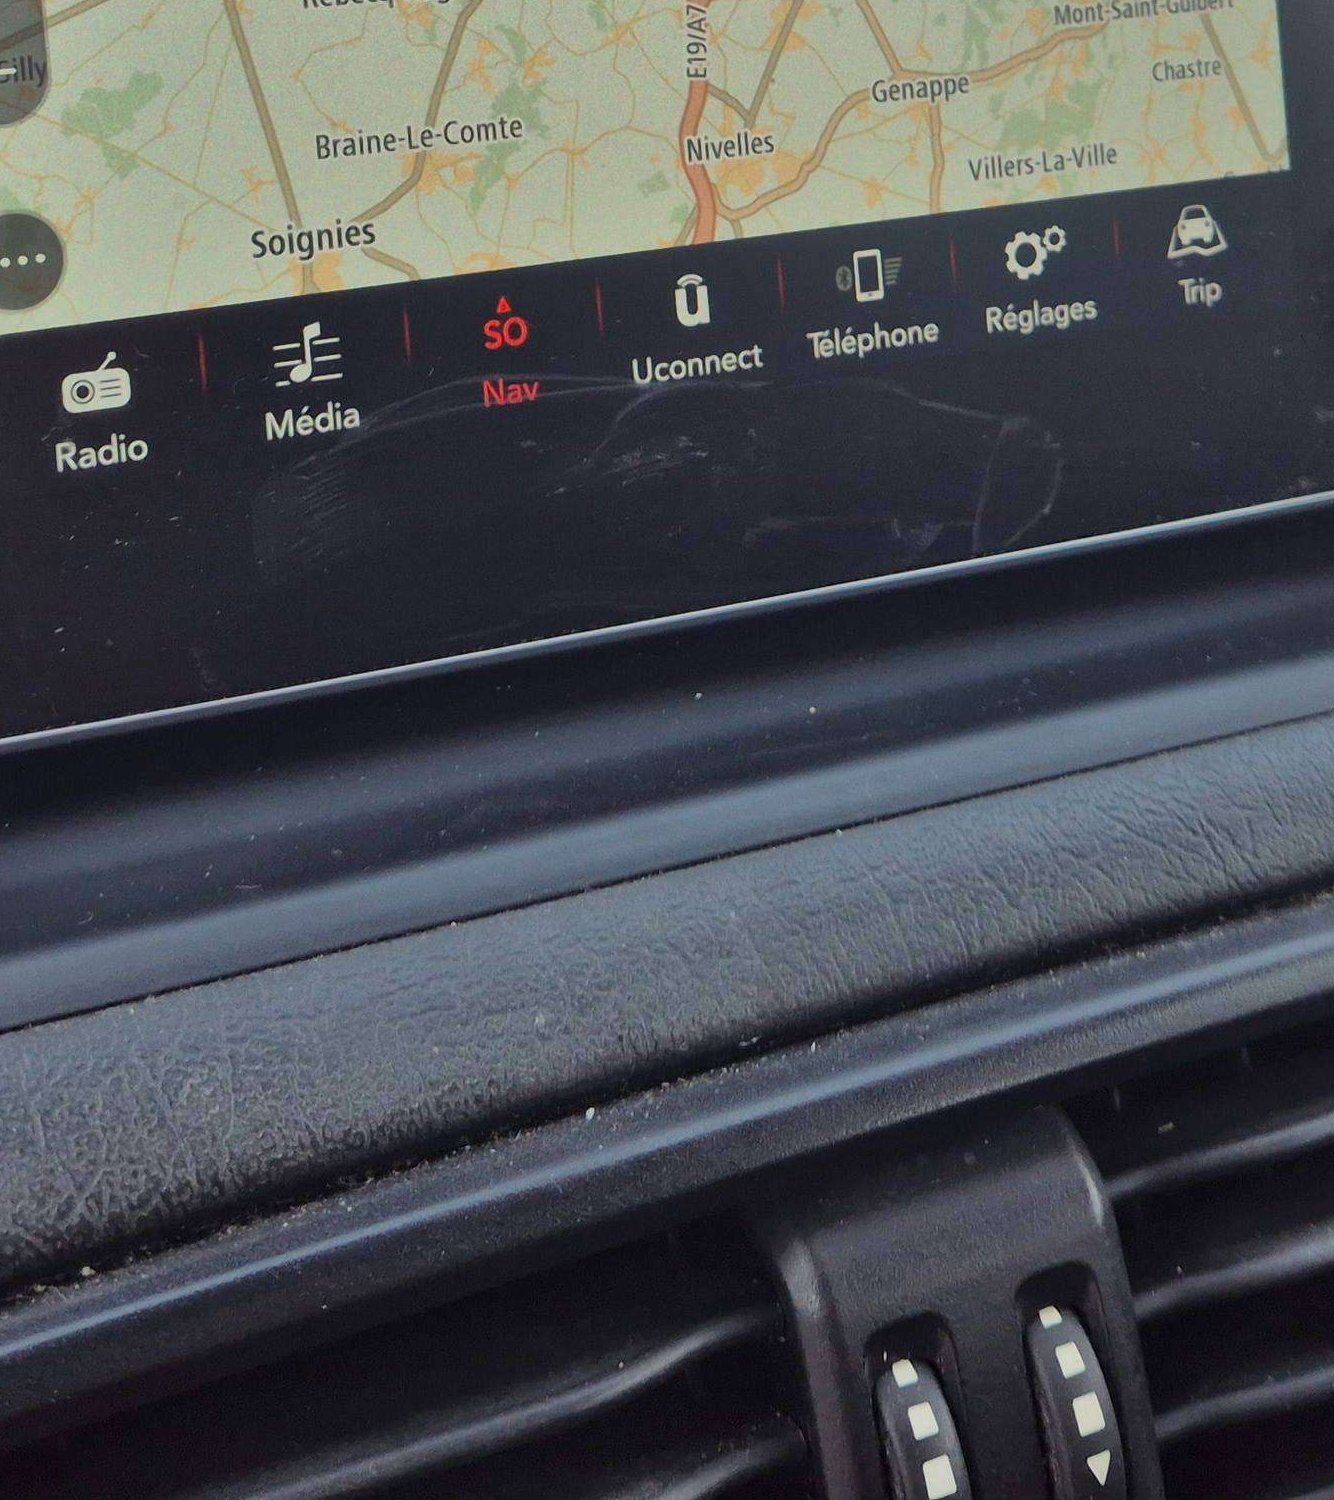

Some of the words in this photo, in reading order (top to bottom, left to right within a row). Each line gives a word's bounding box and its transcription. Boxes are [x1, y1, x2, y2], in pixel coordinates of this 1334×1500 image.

[687, 4, 708, 79] E19/A7
[1152, 56, 1222, 83] Chastre
[871, 74, 970, 104] Genappe
[315, 116, 523, 160] Braine-Le-Comte
[687, 131, 774, 164] Nivelles
[968, 143, 1118, 181] Villers-La-Ville
[251, 217, 376, 260] Soignies
[1177, 276, 1223, 308] Trip
[483, 316, 530, 350] SO
[985, 297, 1099, 334] Réglages
[806, 318, 939, 360] Téléphone
[631, 344, 763, 385] Uconnect
[482, 375, 541, 408] Nav
[265, 401, 361, 441] Média
[55, 433, 149, 473] Radio
